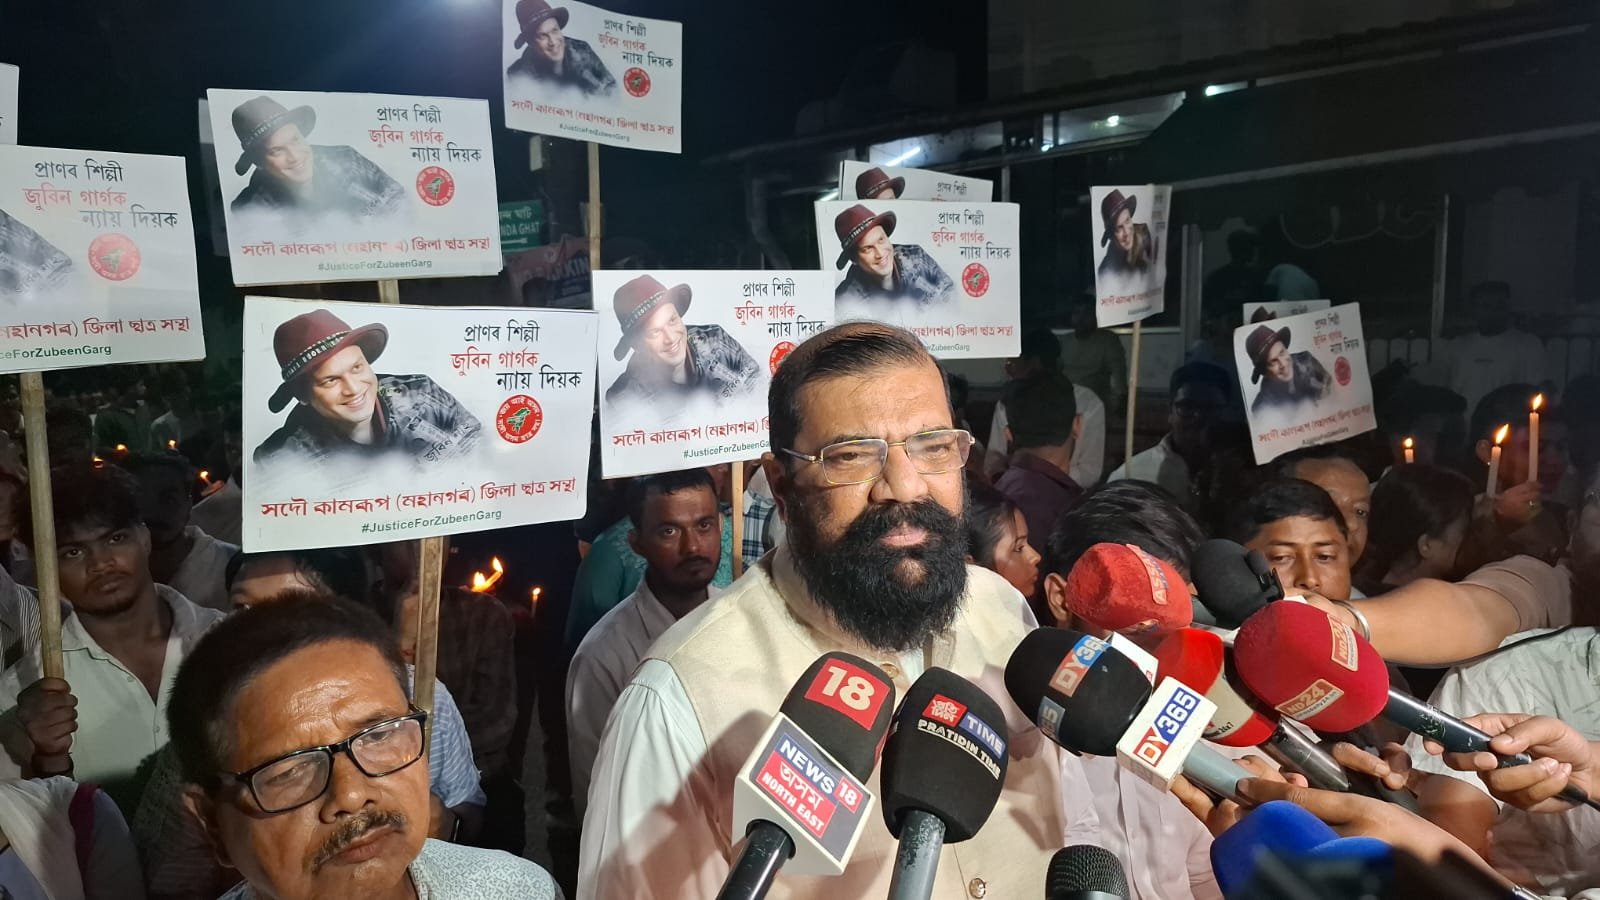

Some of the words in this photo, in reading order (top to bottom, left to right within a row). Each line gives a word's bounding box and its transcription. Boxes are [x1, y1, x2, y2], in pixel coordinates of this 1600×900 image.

[0, 344, 112, 360] ceForZubeenGarg
[683, 441, 770, 459] #JusticeForZubeenGa
[361, 509, 502, 534] #JusticeForZubeenGarg
[1055, 635, 1106, 690] DY36
[822, 666, 876, 712] 18
[918, 718, 979, 755] PRATIDIN
[980, 750, 1001, 778] TIME
[967, 714, 1003, 754] TIME
[1137, 690, 1197, 766] DY365
[780, 739, 835, 794] NEWS
[839, 781, 858, 806] 18
[780, 760, 825, 811] অসম
[761, 771, 798, 808] NORTH
[796, 803, 825, 831] EAST
